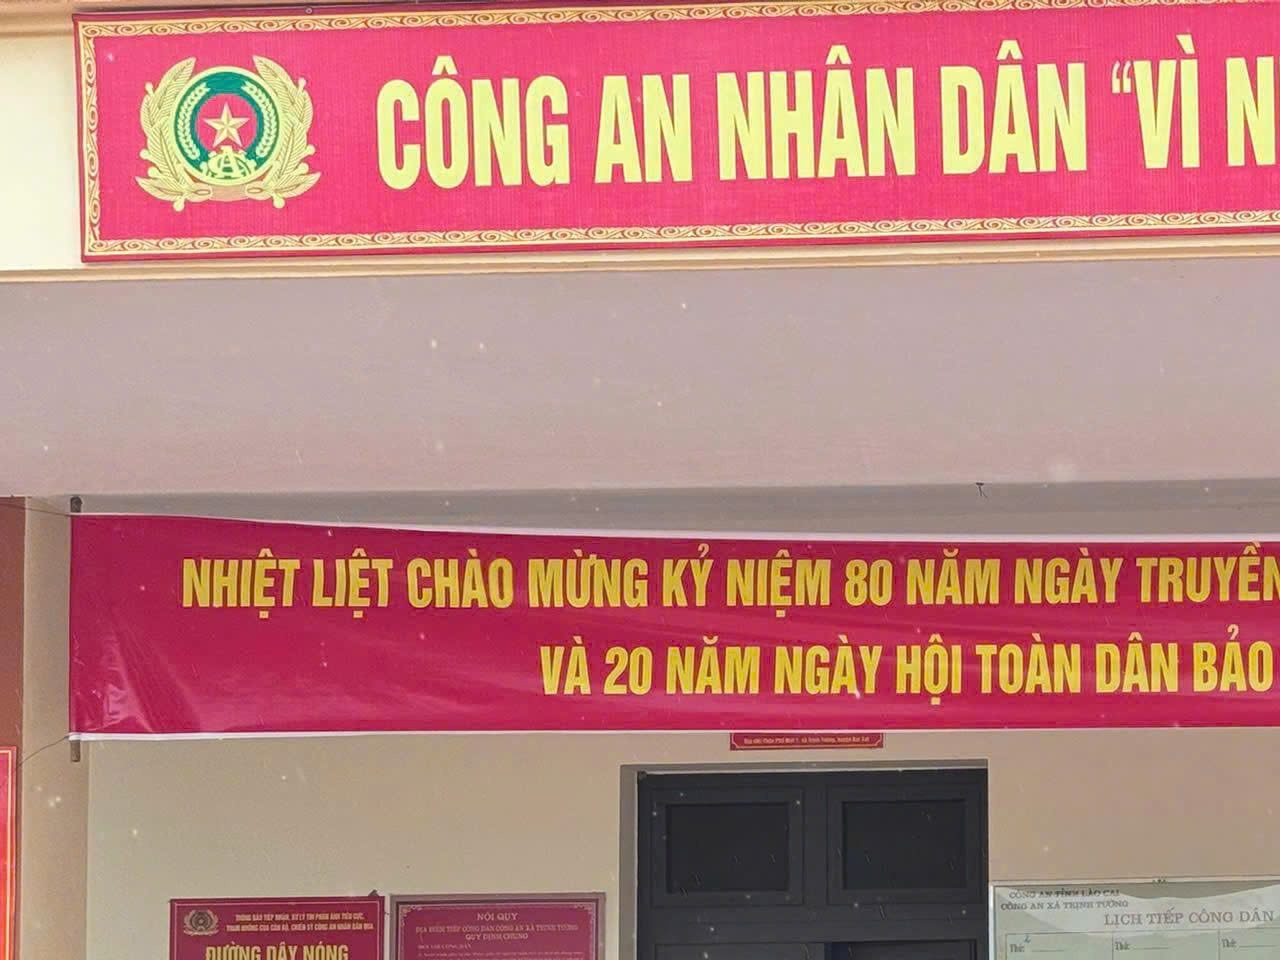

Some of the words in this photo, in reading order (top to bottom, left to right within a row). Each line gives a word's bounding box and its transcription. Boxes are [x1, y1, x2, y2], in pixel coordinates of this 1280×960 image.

[377, 56, 570, 189] CÔNG
[595, 74, 692, 183] AN
[717, 45, 915, 180] NHÂN
[941, 40, 1087, 174] DÂN
[183, 549, 300, 618] NHIỆT
[313, 549, 392, 617] LIỆT
[408, 549, 513, 608] CHÀO
[529, 550, 647, 607] MỪNG
[663, 544, 713, 606] KỶ
[727, 550, 830, 617] NIỆM
[845, 560, 892, 605] 80
[907, 549, 1000, 604] NĂM
[1015, 548, 1122, 603] NGÀY
[541, 636, 591, 694] VÀ
[604, 647, 652, 694] 20
[667, 636, 760, 694] NĂM
[775, 635, 882, 698] NGÀY
[896, 634, 961, 705] HỘI
[976, 633, 1080, 693] TOÀN
[1096, 632, 1178, 692] DÂN
[1193, 624, 1273, 691] BẢO
[1146, 907, 1184, 924] TIẾP
[1188, 909, 1233, 924] CÔNG
